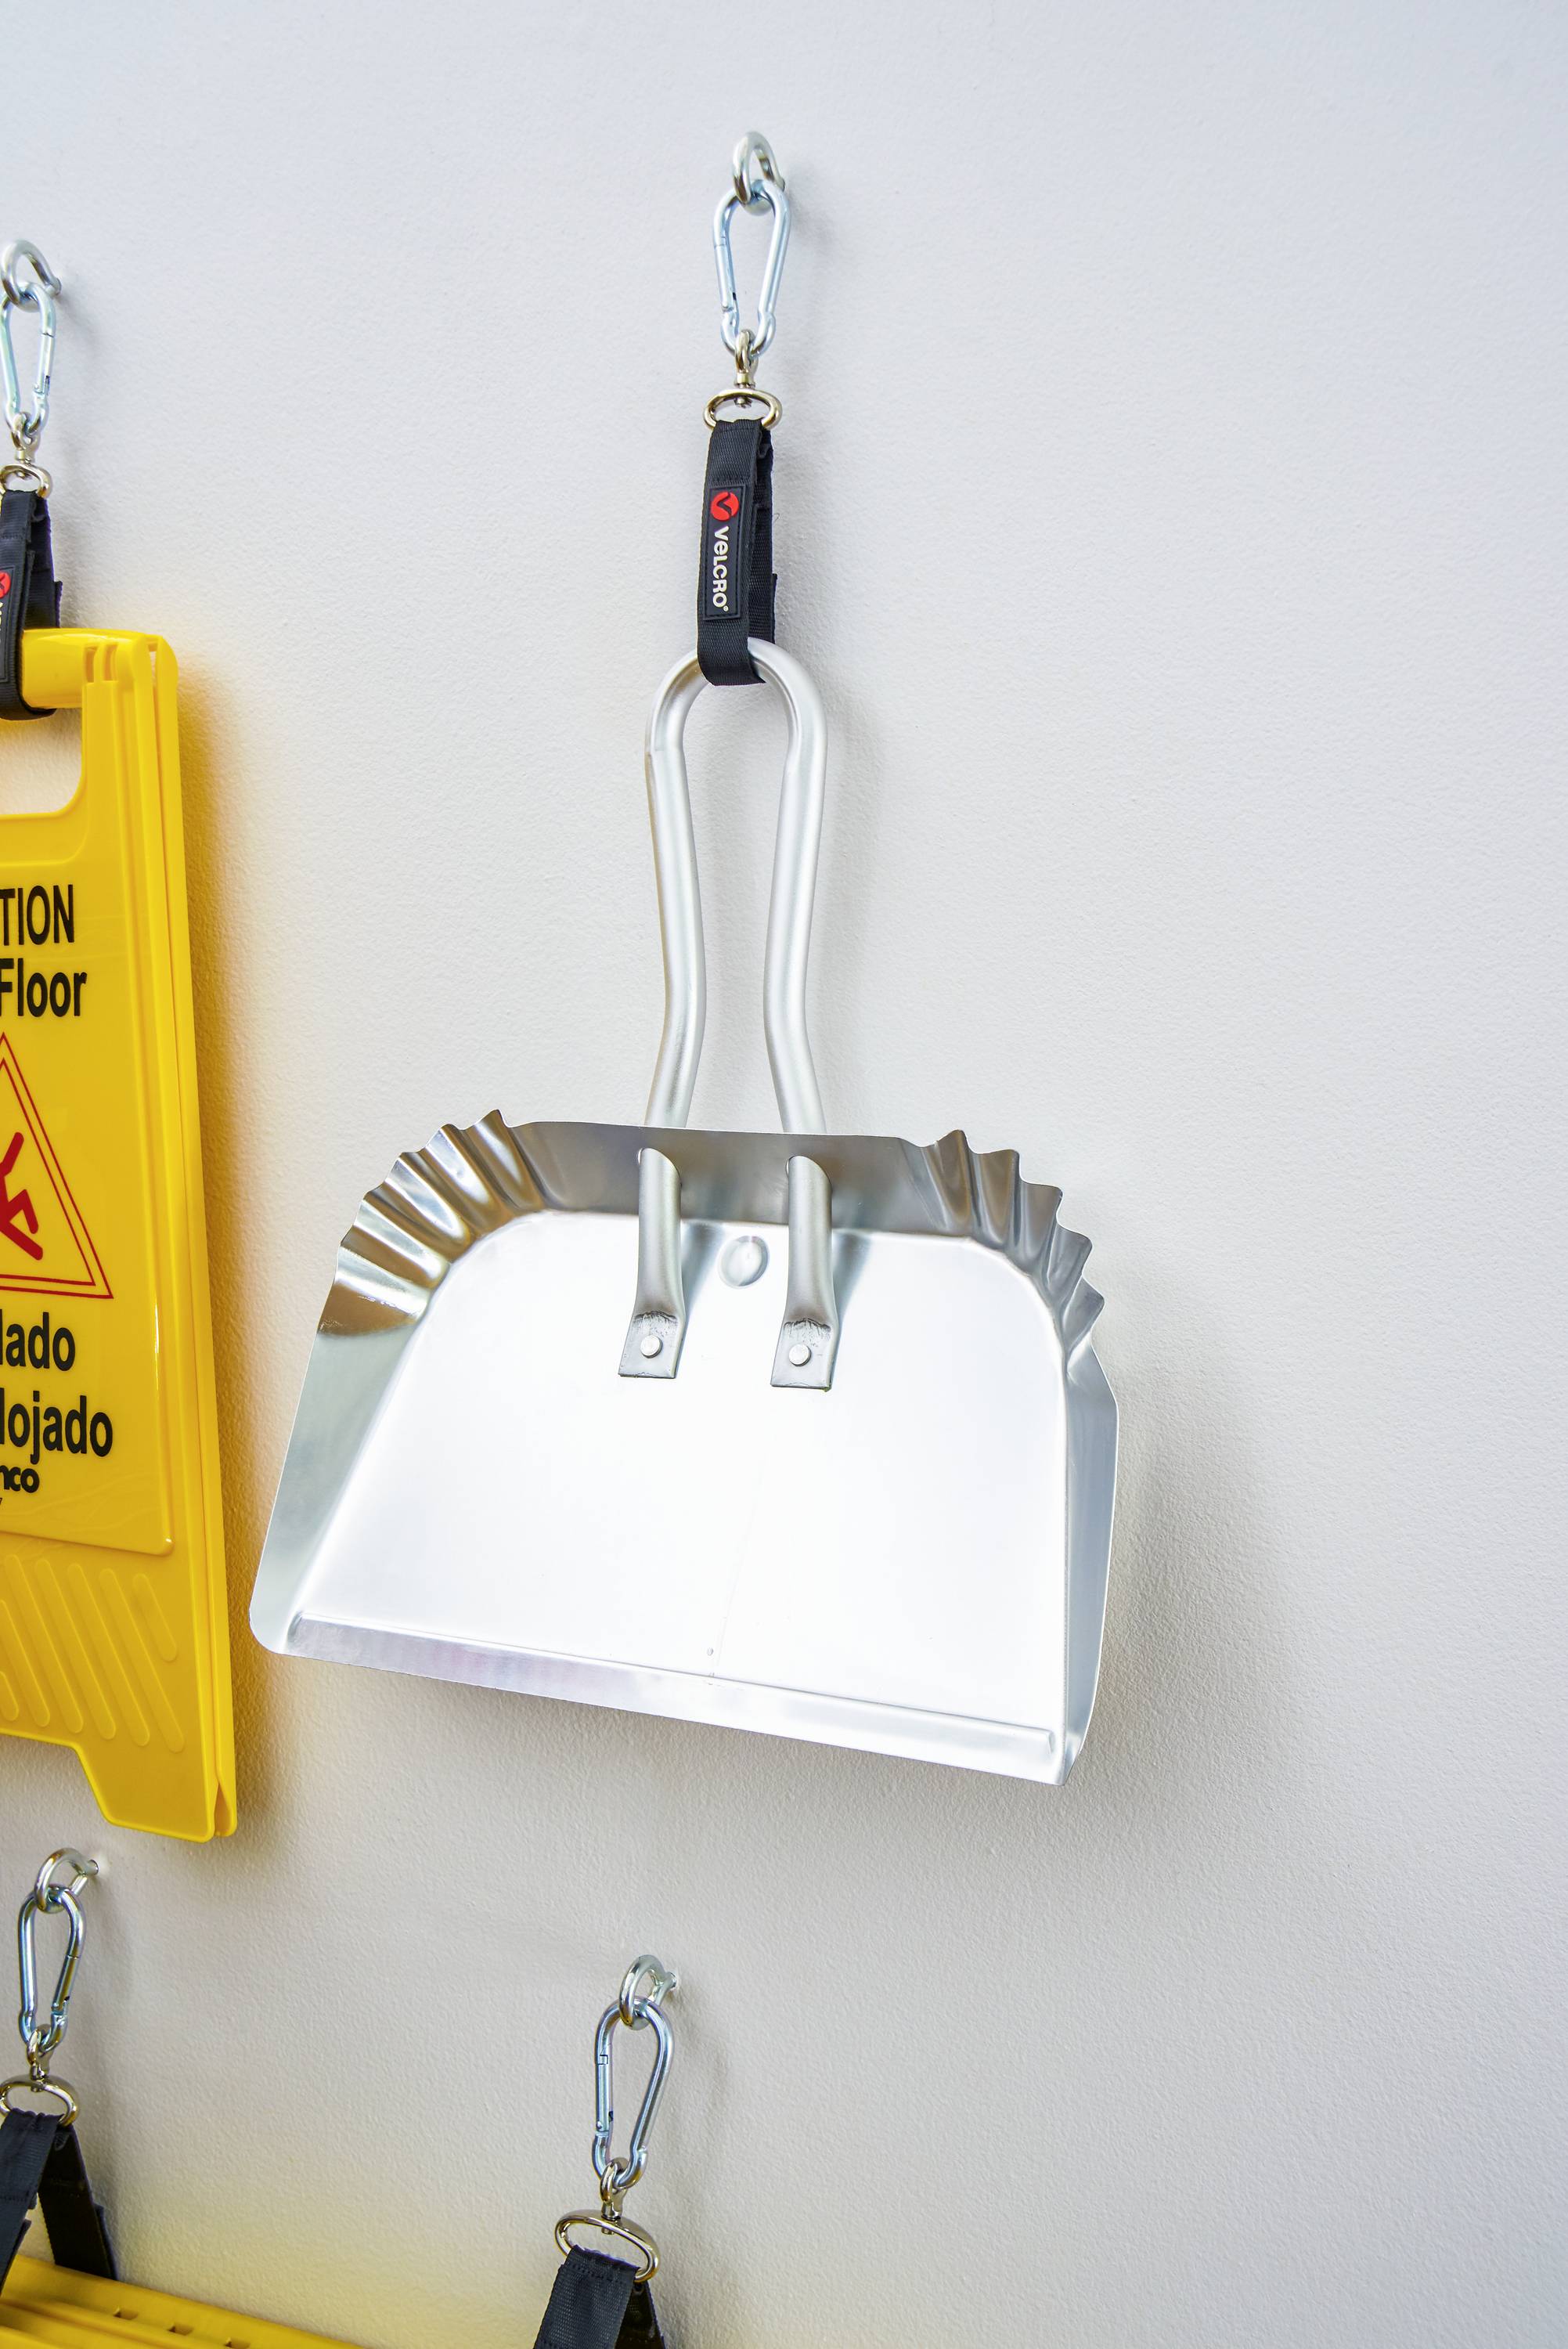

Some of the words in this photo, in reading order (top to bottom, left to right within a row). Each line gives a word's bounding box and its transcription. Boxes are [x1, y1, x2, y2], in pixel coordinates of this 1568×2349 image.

[0, 884, 75, 946] TION
[0, 958, 88, 1018] Floor
[0, 1308, 76, 1372] ado
[0, 1387, 114, 1465] ojado
